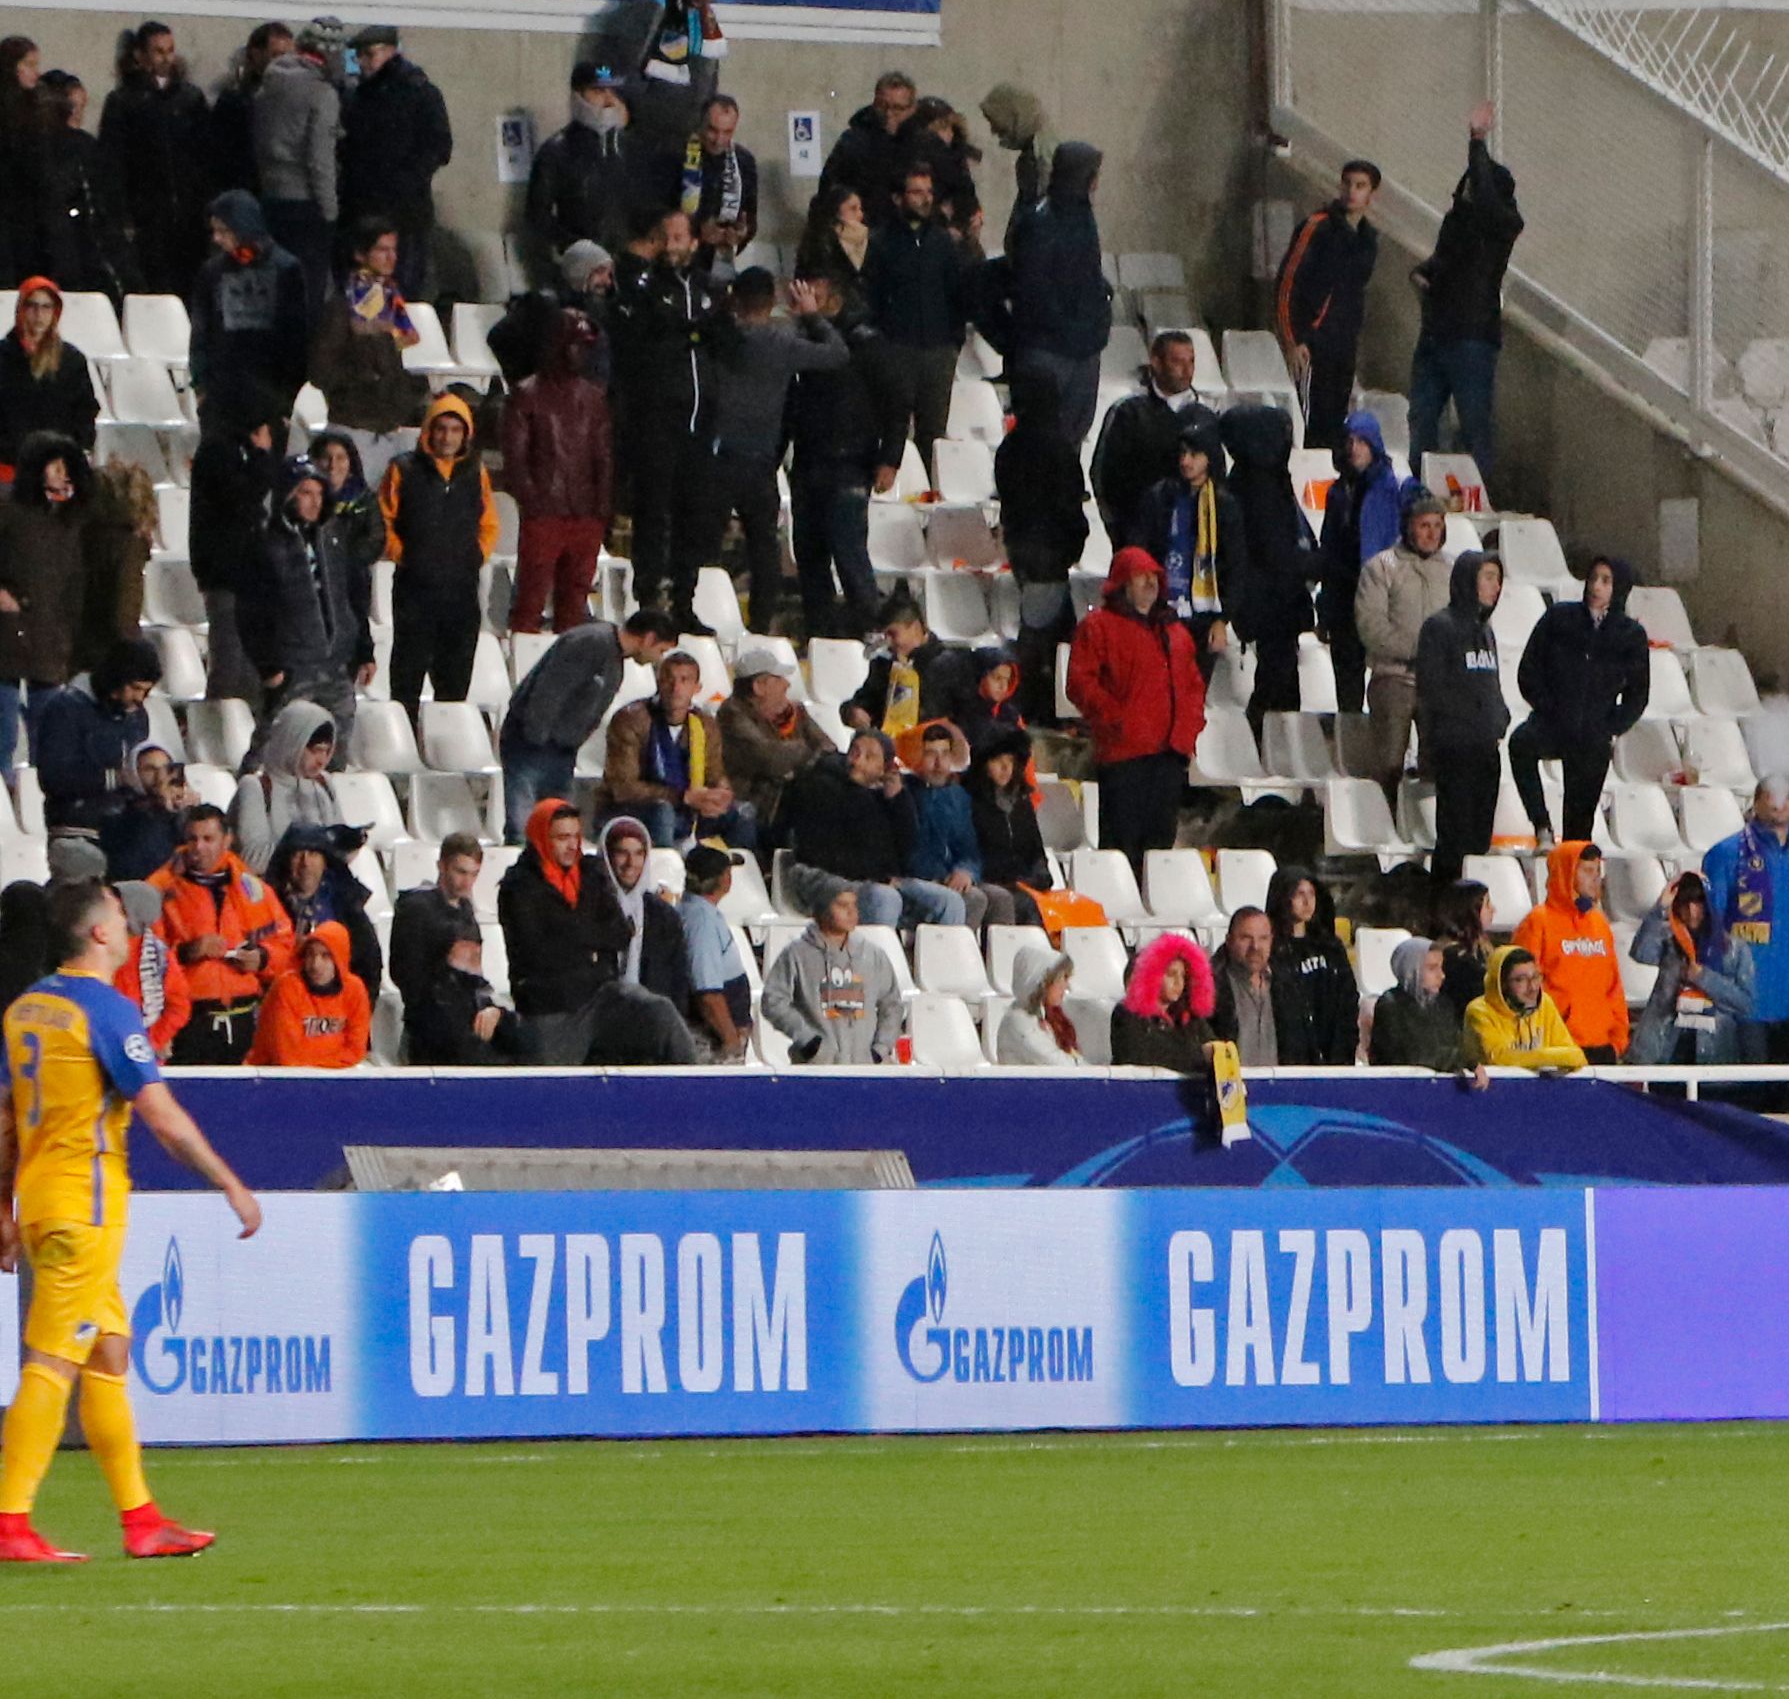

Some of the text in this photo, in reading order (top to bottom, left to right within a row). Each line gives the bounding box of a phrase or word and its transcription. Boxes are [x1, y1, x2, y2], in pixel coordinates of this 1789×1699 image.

[408, 1231, 808, 1398] GAZPROM
[952, 1326, 1093, 1384] GAZPROM
[1168, 1227, 1571, 1388] GAZPROM
[190, 1335, 331, 1394] GAZPROM
